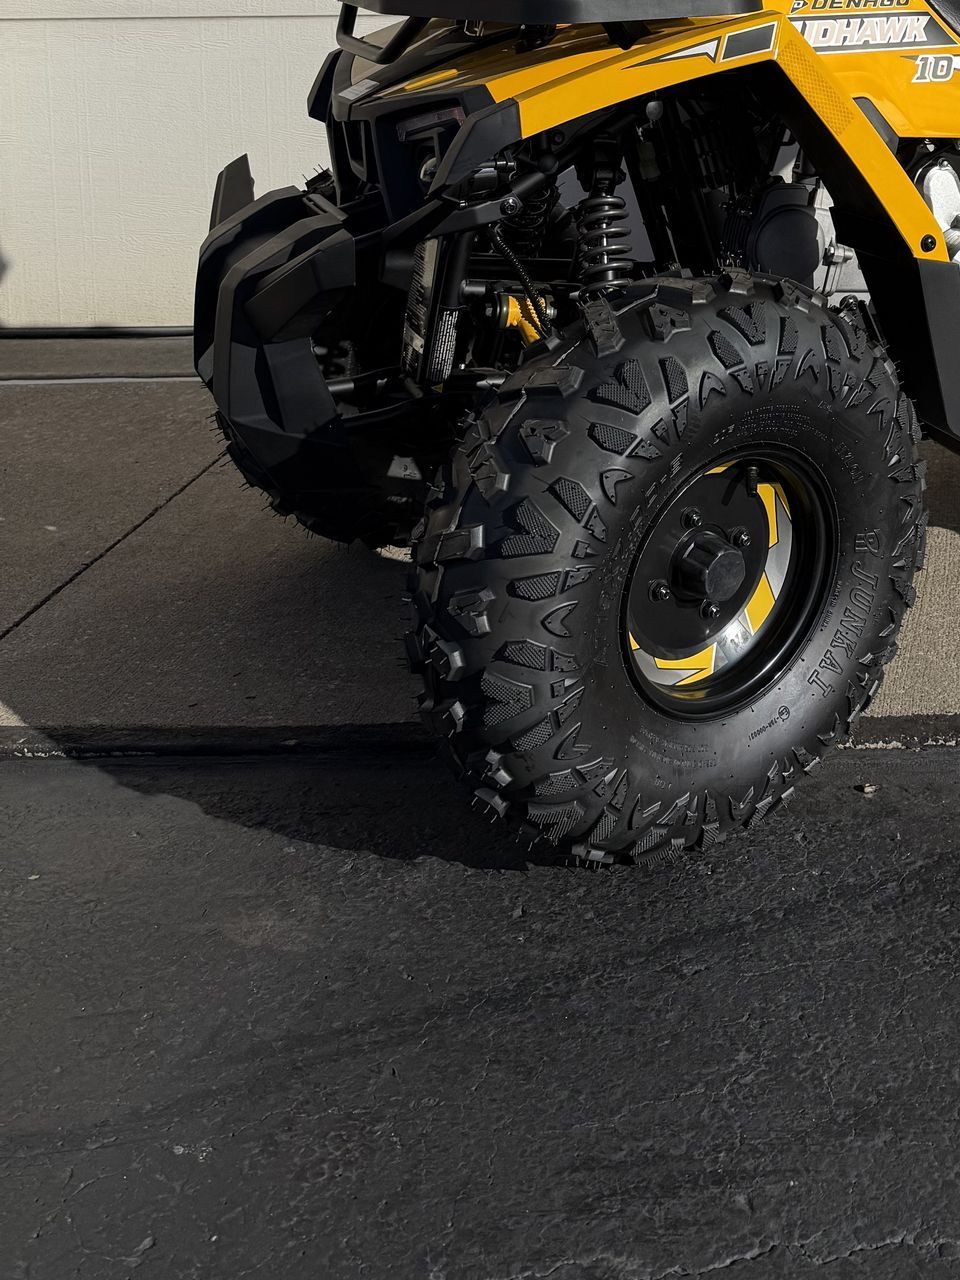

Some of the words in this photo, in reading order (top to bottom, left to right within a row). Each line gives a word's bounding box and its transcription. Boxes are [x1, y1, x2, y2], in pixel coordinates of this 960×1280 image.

[790, 15, 931, 46] UDHAWK
[912, 54, 954, 83] 10
[807, 561, 879, 697] JUNKAI
